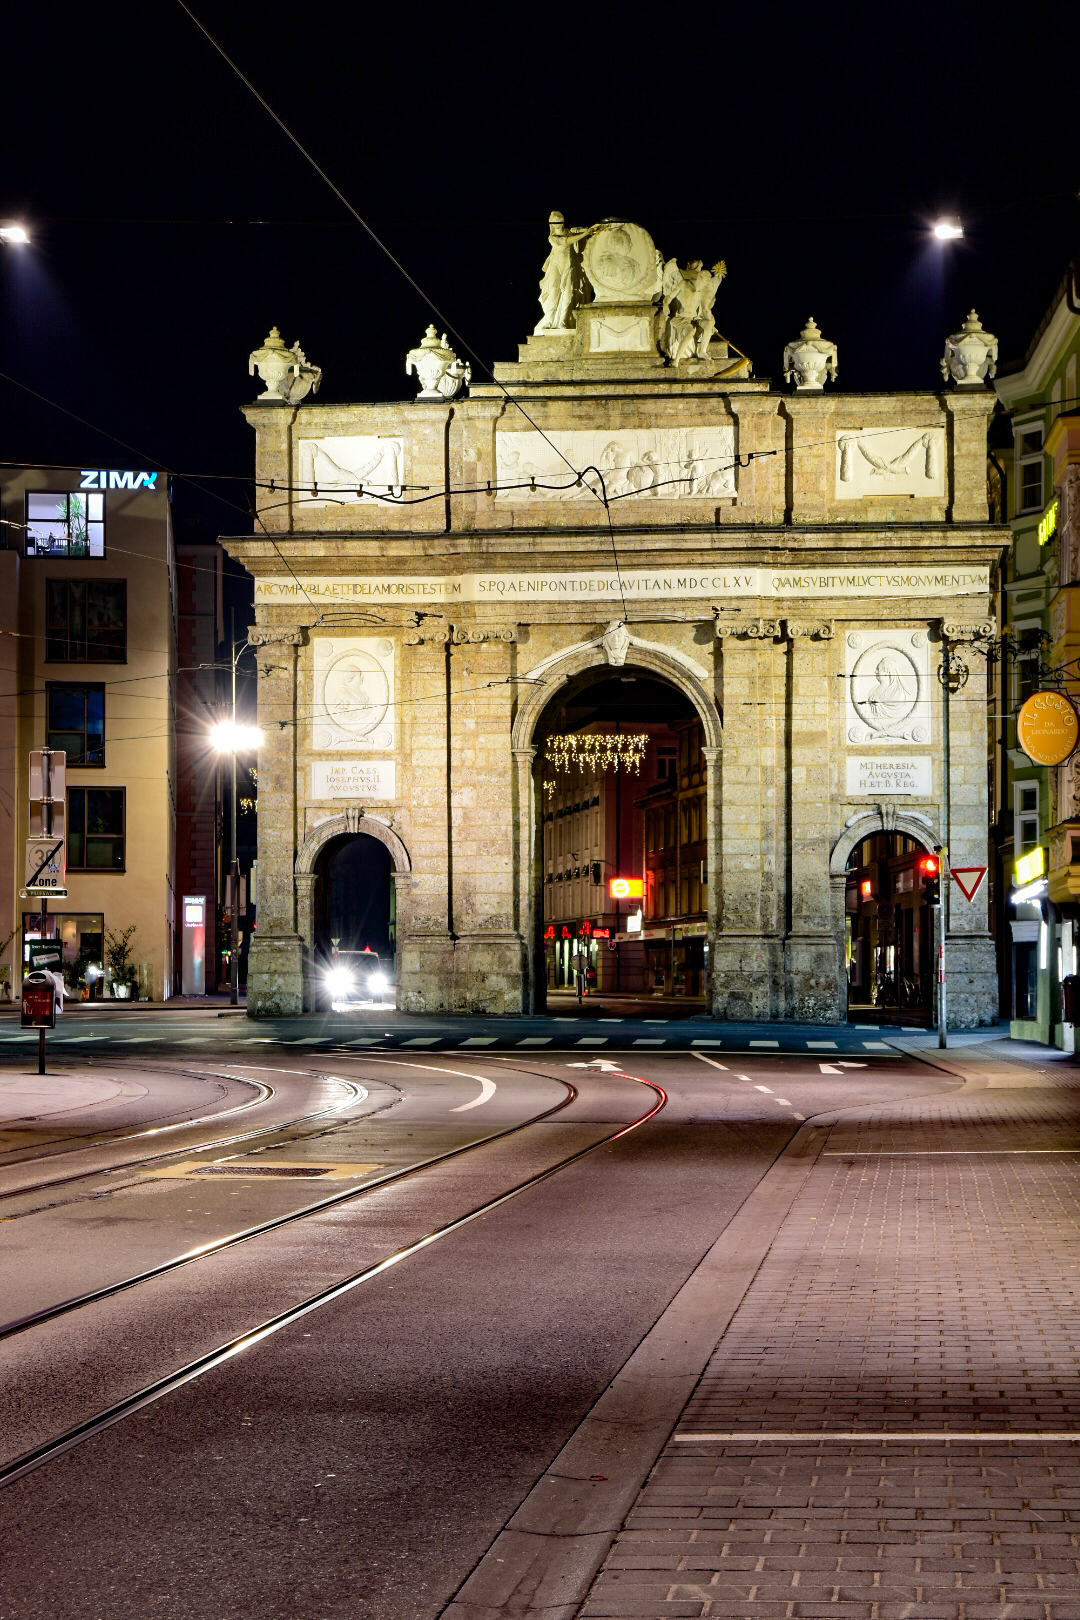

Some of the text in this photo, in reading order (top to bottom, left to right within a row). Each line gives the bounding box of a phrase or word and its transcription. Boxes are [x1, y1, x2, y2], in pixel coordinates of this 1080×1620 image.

[79, 471, 158, 490] ZIMA
[1023, 694, 1075, 727] IL GUSTO
[1025, 735, 1038, 753] NON
[1037, 752, 1058, 762] SOLO
[34, 848, 56, 868] 30
